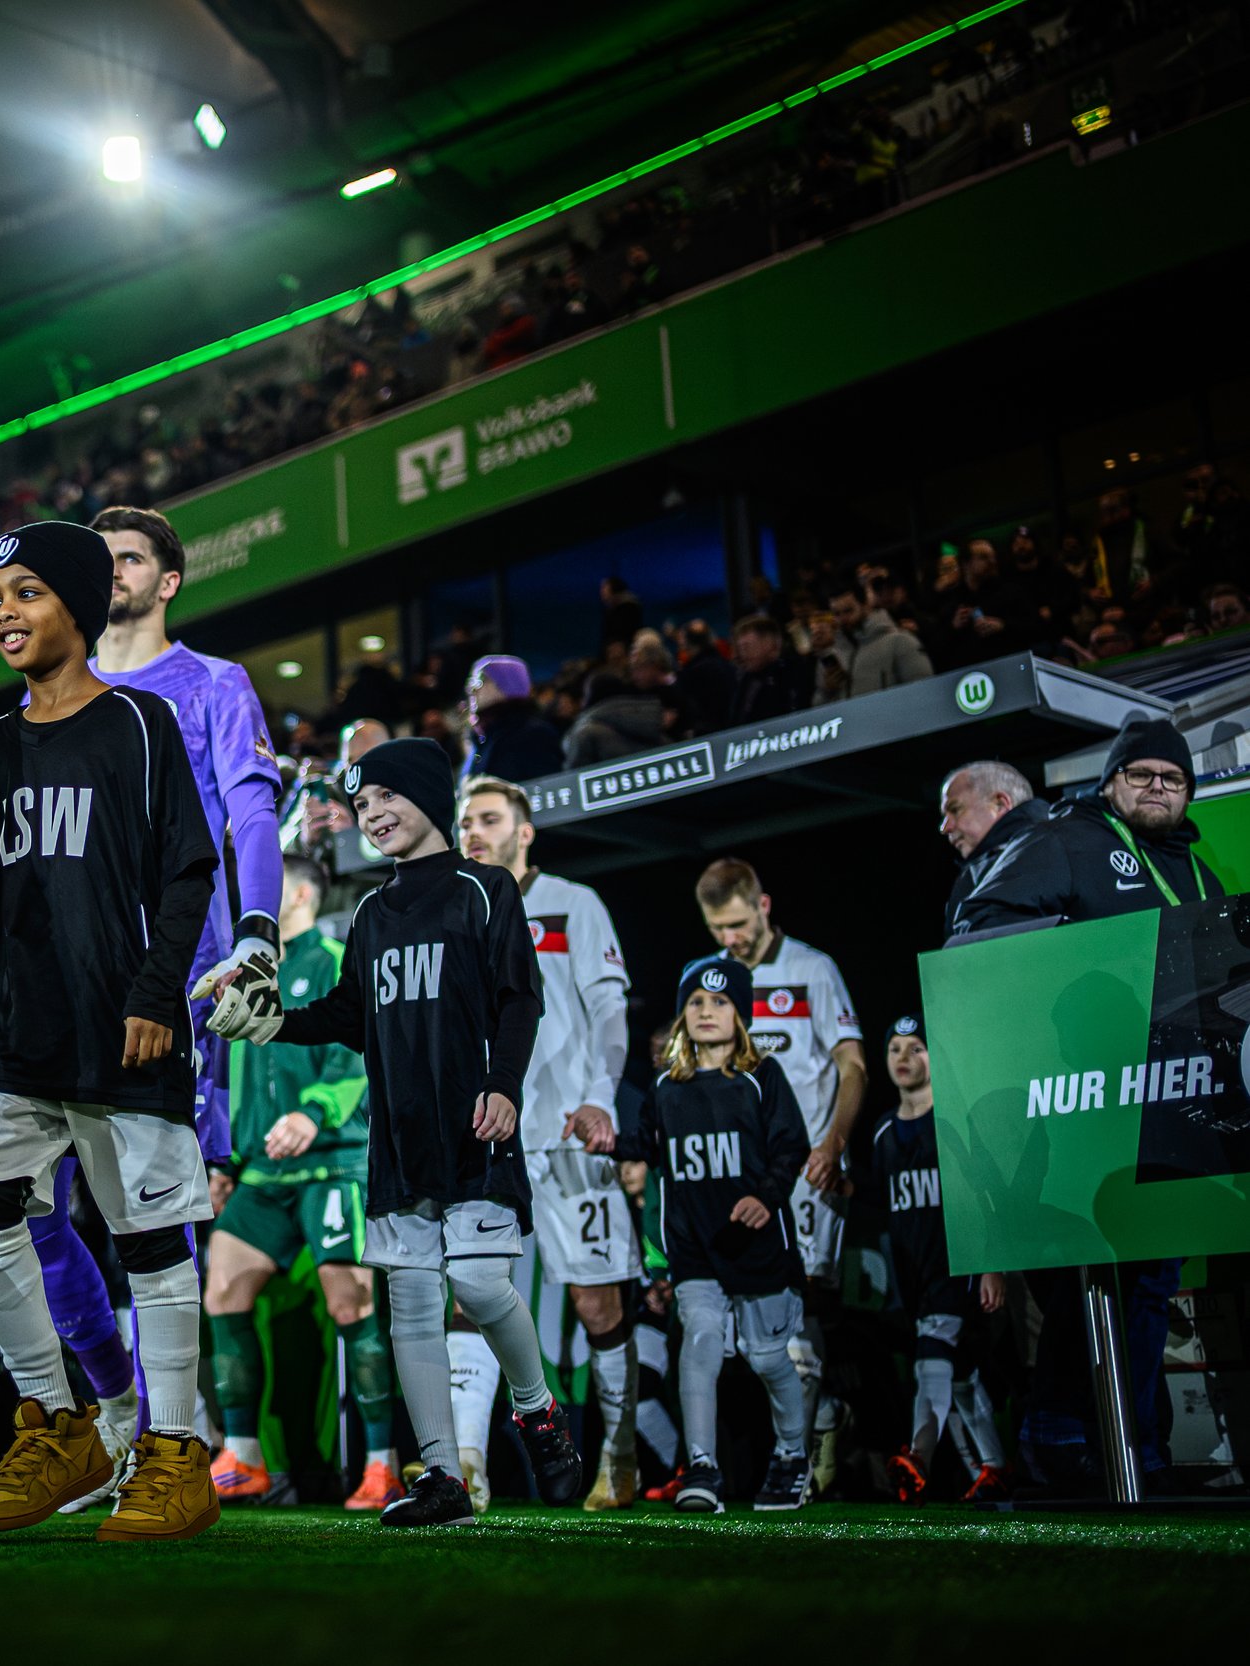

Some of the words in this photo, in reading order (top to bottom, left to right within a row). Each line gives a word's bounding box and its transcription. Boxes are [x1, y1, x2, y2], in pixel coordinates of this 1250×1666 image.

[591, 755, 704, 798] FUSSBALL
[1026, 1069, 1106, 1119] NUR
[1119, 1055, 1225, 1106] HIER.
[668, 1130, 742, 1182] LSW
[323, 1188, 345, 1231] 4
[889, 1167, 941, 1213] LSW
[579, 1197, 610, 1243] 21
[799, 1201, 815, 1235] 3
